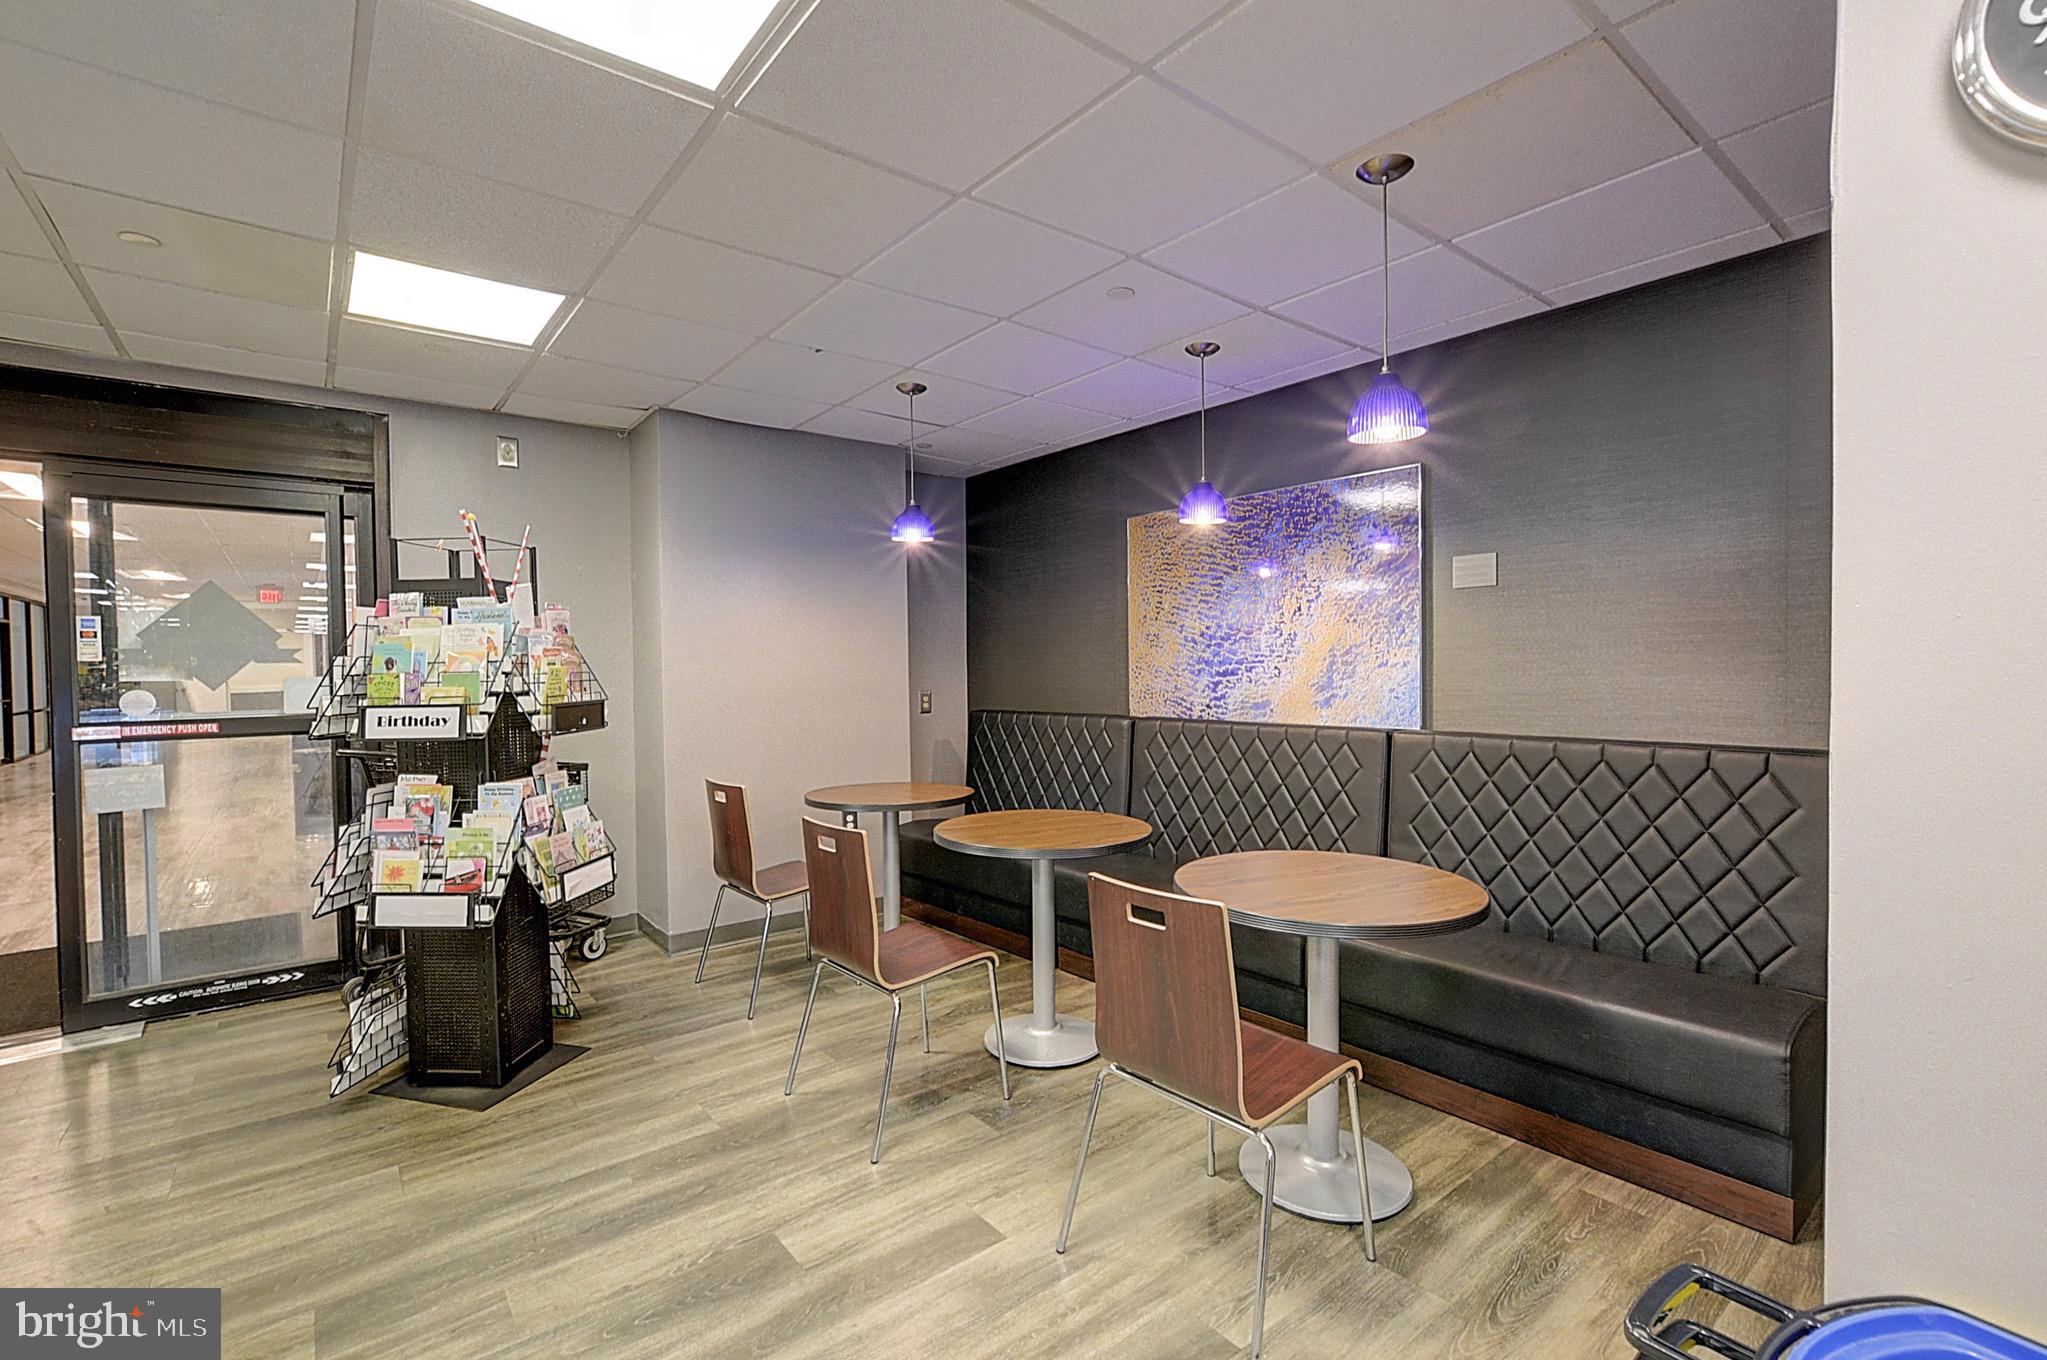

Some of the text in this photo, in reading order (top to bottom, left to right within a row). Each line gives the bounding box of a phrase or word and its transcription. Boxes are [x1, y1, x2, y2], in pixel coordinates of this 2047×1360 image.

[377, 715, 451, 728] Birthday
[121, 727, 130, 737] IN
[132, 725, 176, 736] EMERGENCY
[178, 724, 197, 733] PUSH
